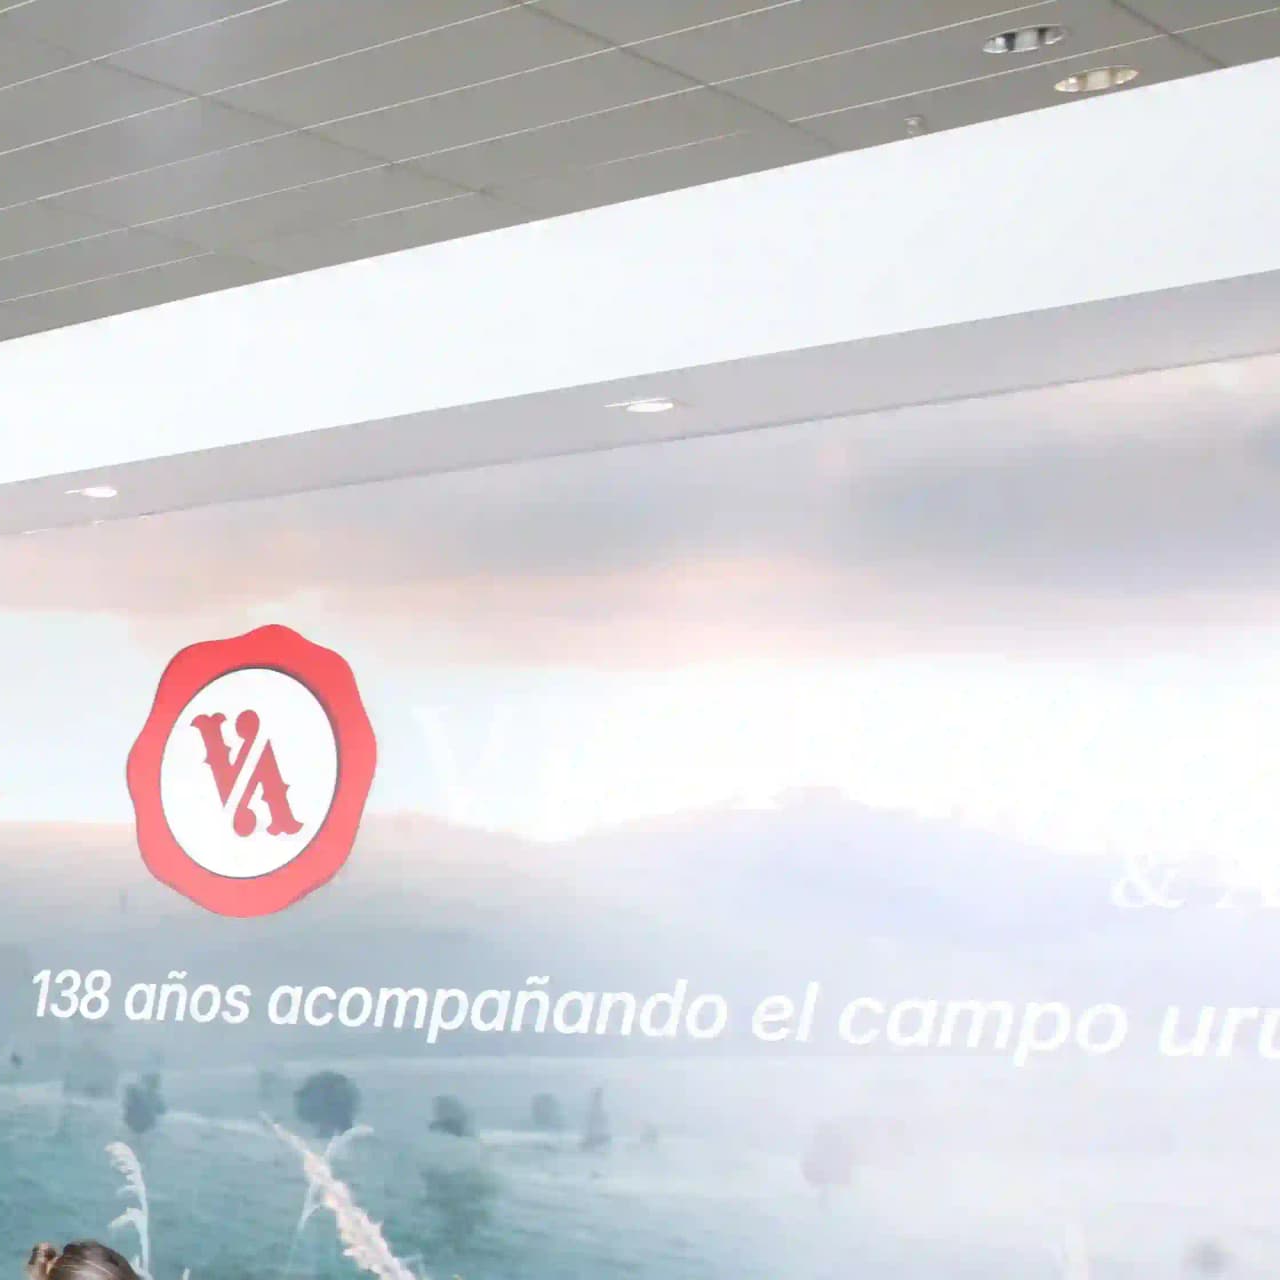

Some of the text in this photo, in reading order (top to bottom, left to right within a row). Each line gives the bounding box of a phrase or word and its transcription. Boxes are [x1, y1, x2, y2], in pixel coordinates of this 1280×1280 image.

[32, 969, 112, 1021] 138
[124, 970, 252, 1024] años
[267, 975, 728, 1044] acompañando
[751, 981, 821, 1042] el
[838, 996, 1129, 1068] campo
